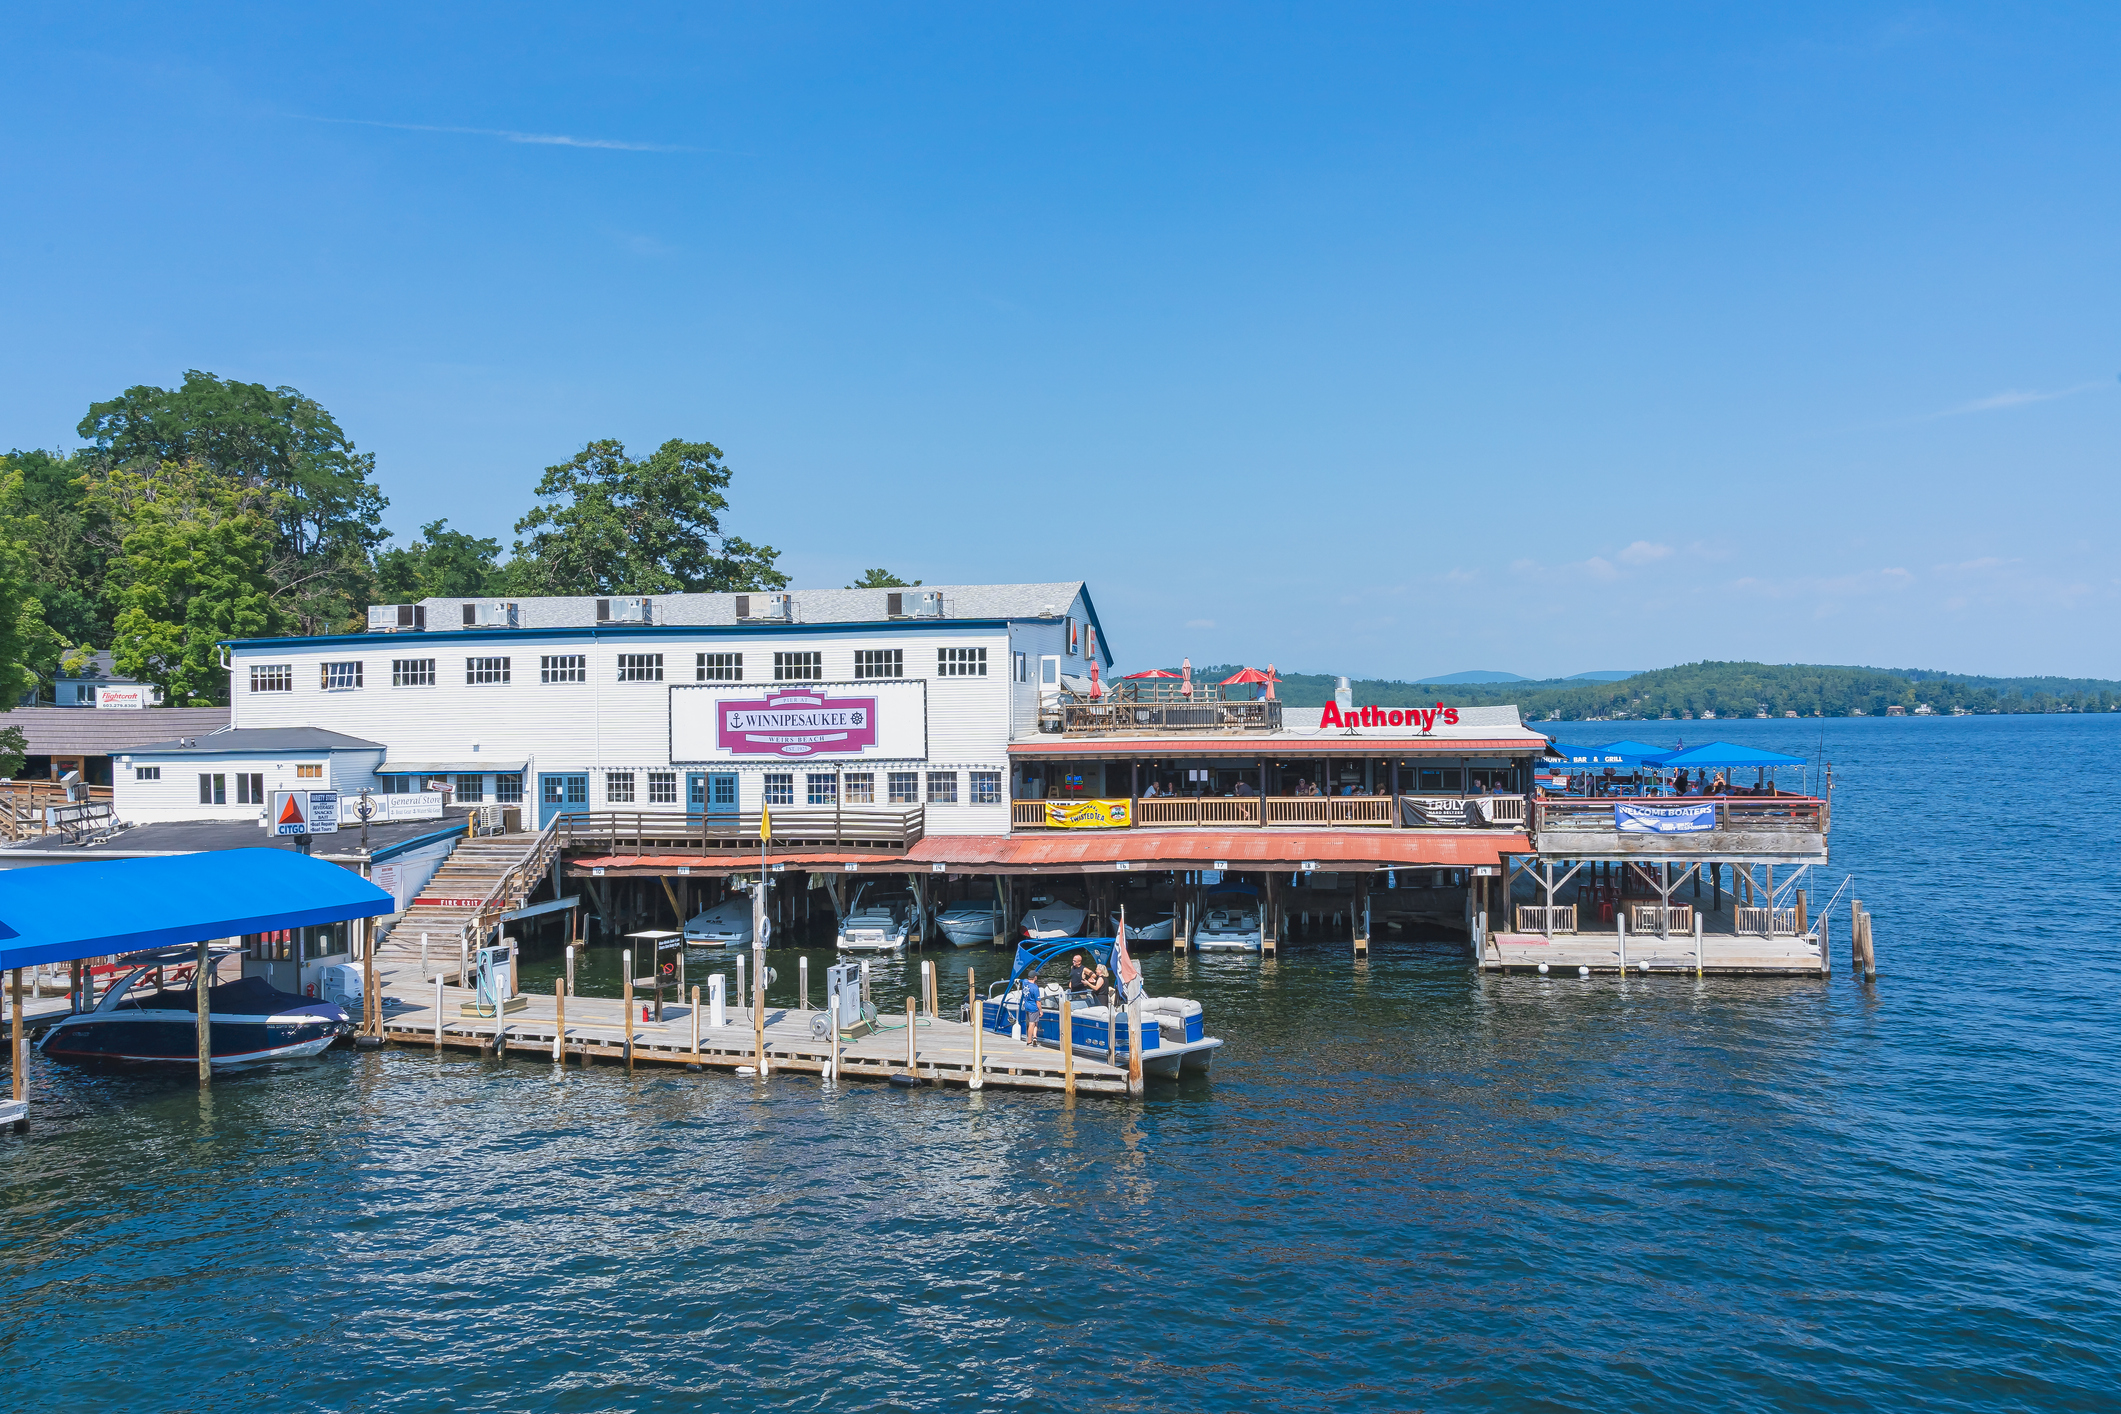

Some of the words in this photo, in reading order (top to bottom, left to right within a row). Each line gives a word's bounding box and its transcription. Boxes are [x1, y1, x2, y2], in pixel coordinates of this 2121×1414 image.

[102, 692, 138, 702] Flightcraft
[746, 713, 847, 727] WINNIPESAUKEE
[1320, 701, 1459, 731] Anthony's
[391, 796, 422, 806] General
[422, 796, 441, 804] Store
[1428, 800, 1466, 810] TRULY
[1618, 805, 1667, 816] WELCOME
[1668, 805, 1712, 816] BOATERS
[1070, 812, 1095, 823] TWISTED
[1095, 813, 1105, 822] TEA
[279, 825, 305, 834] CITGO
